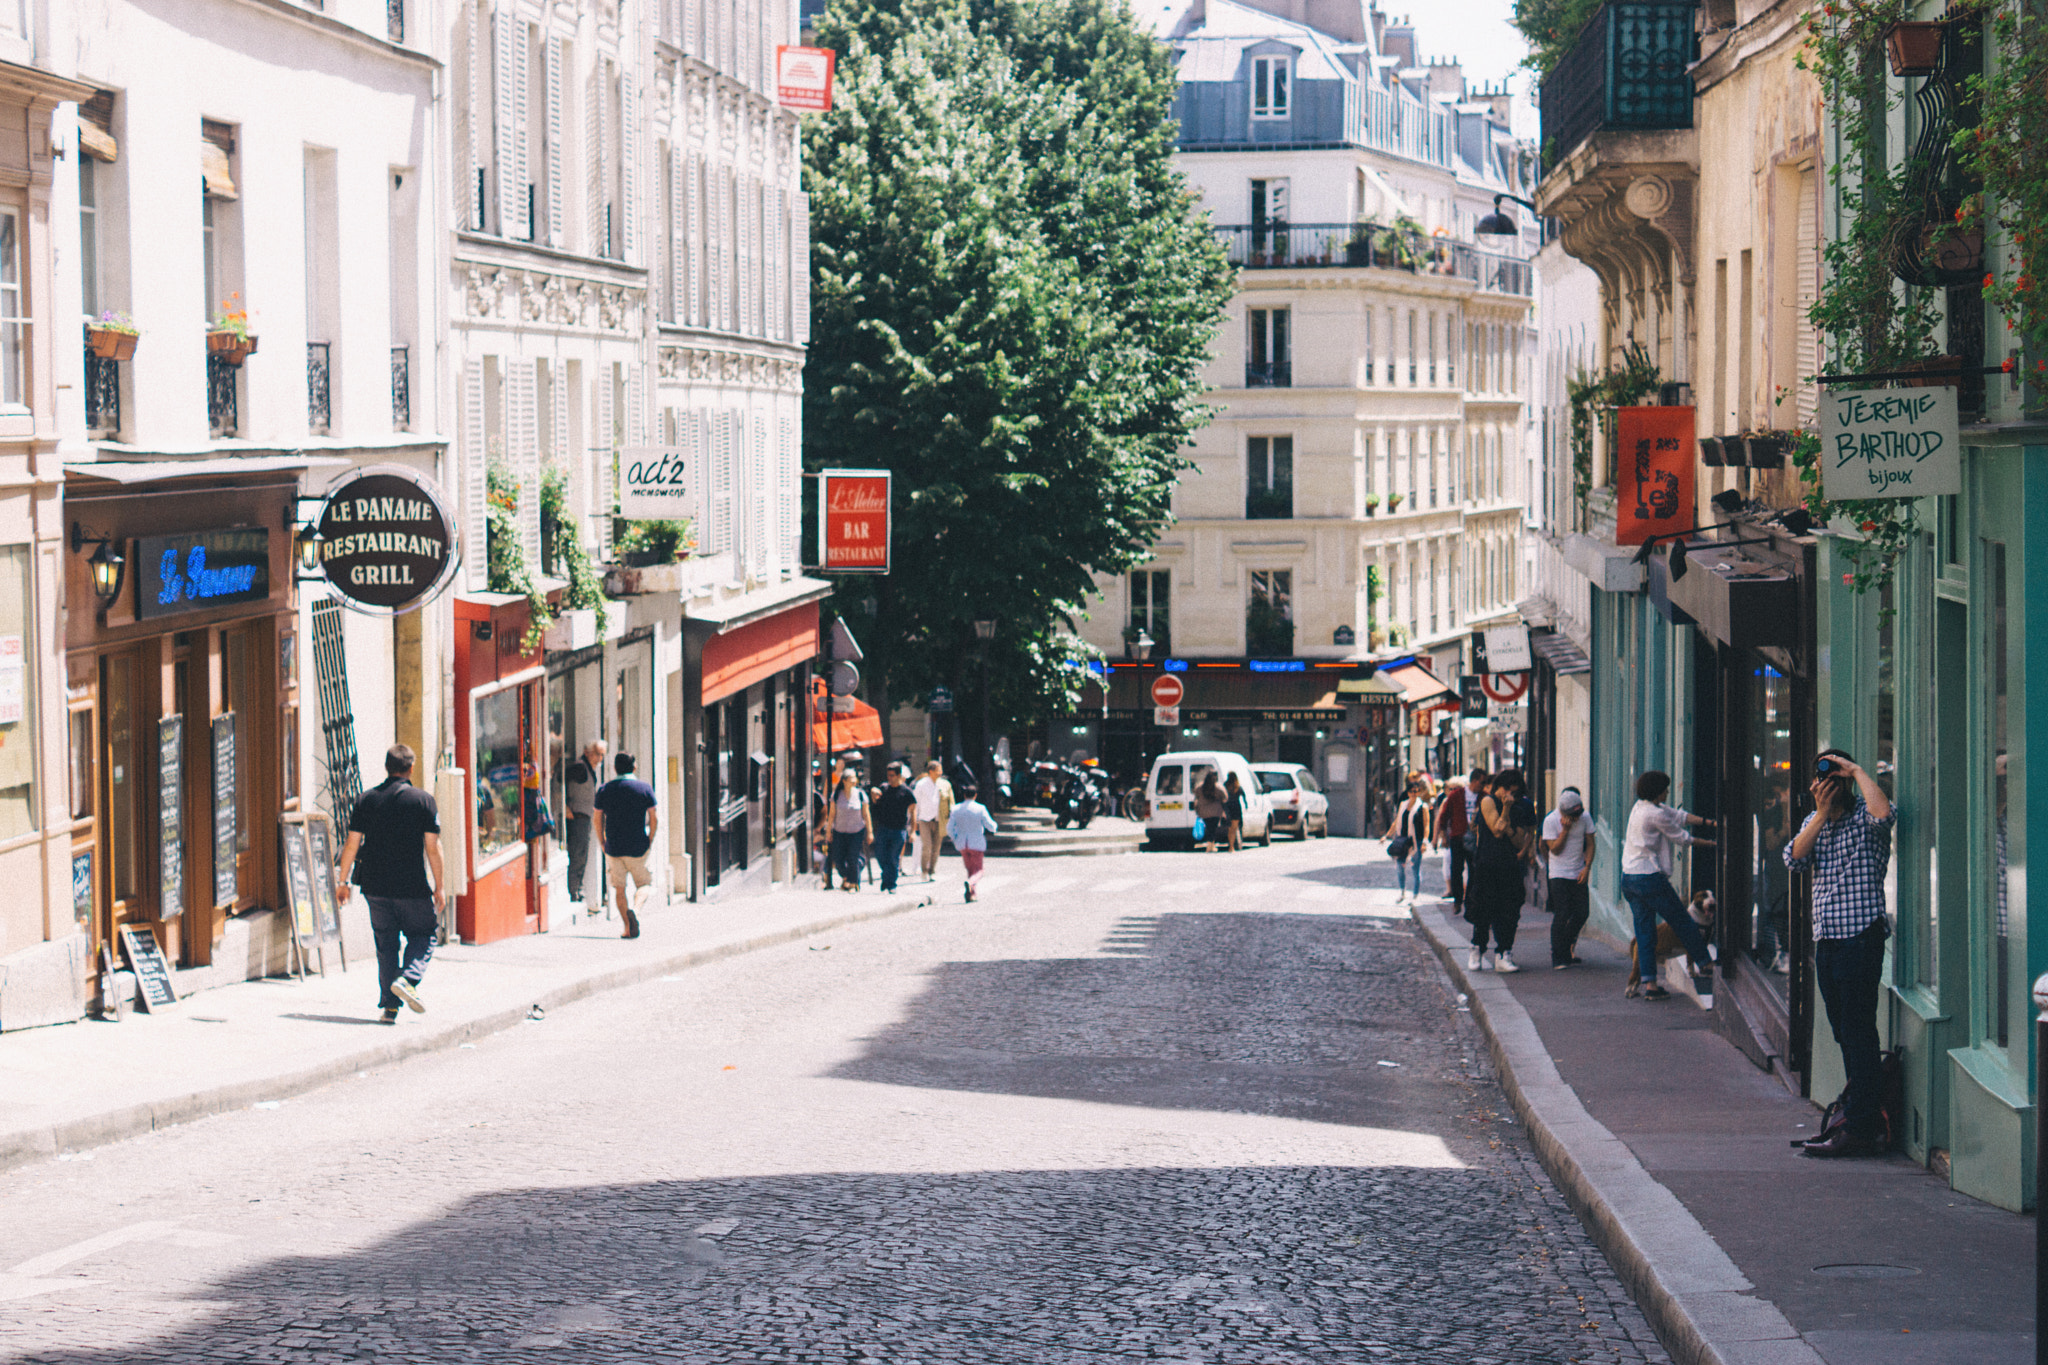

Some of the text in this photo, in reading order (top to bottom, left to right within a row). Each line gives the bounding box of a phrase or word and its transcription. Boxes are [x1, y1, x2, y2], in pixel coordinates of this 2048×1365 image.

[1837, 394, 1936, 427] JÉRÉMIE
[1834, 431, 1943, 468] BARTHOD
[1868, 468, 1913, 493] bijoux
[331, 497, 432, 522] LE PANAME
[844, 522, 869, 539] BAR
[323, 532, 442, 562] RESTAURANT
[828, 547, 886, 560] RESTAURANT
[351, 565, 414, 585] GRILL
